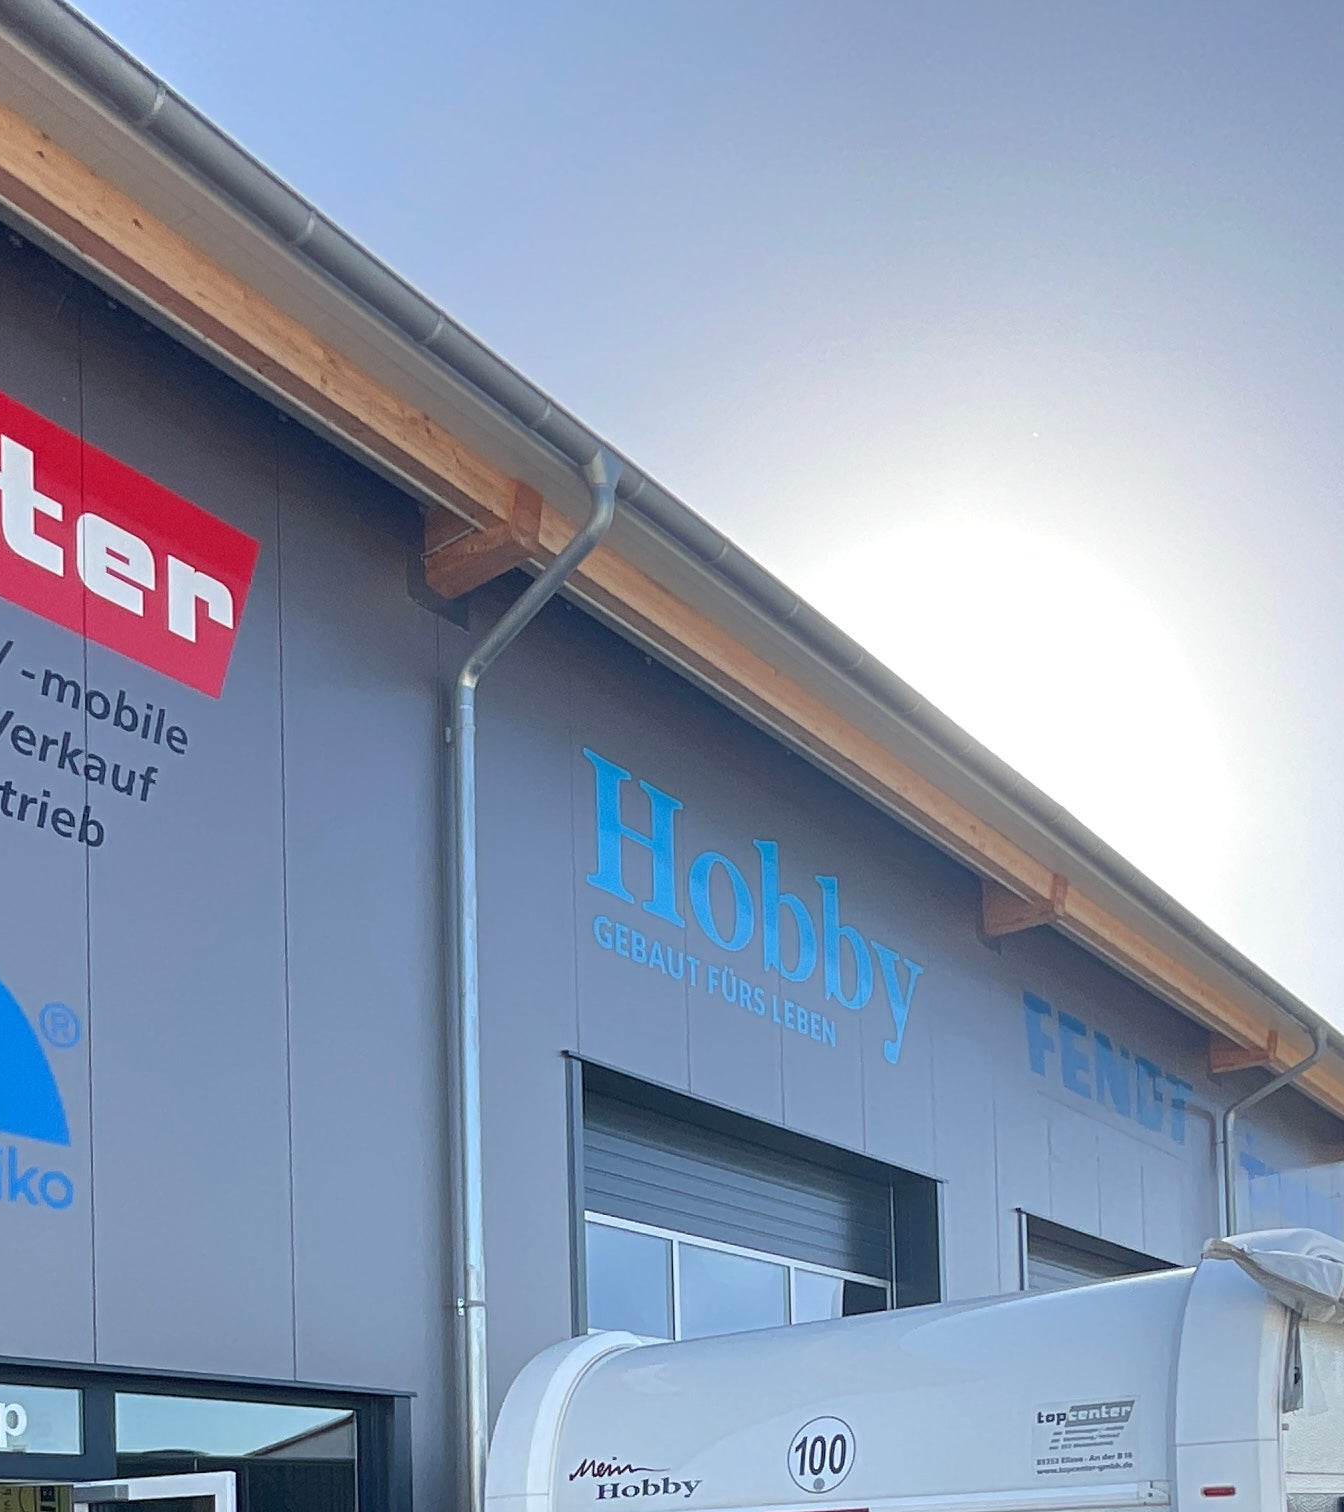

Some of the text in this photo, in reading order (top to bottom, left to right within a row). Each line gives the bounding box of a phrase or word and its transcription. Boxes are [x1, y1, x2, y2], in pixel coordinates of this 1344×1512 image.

[582, 747, 923, 1064] Hobby
[593, 915, 836, 1047] GEBAUT FÜRS LEBEN
[1023, 991, 1193, 1146] FENDT
[569, 1456, 670, 1481] Mein
[596, 1477, 703, 1500] Hobby
[795, 1434, 846, 1476] 100
